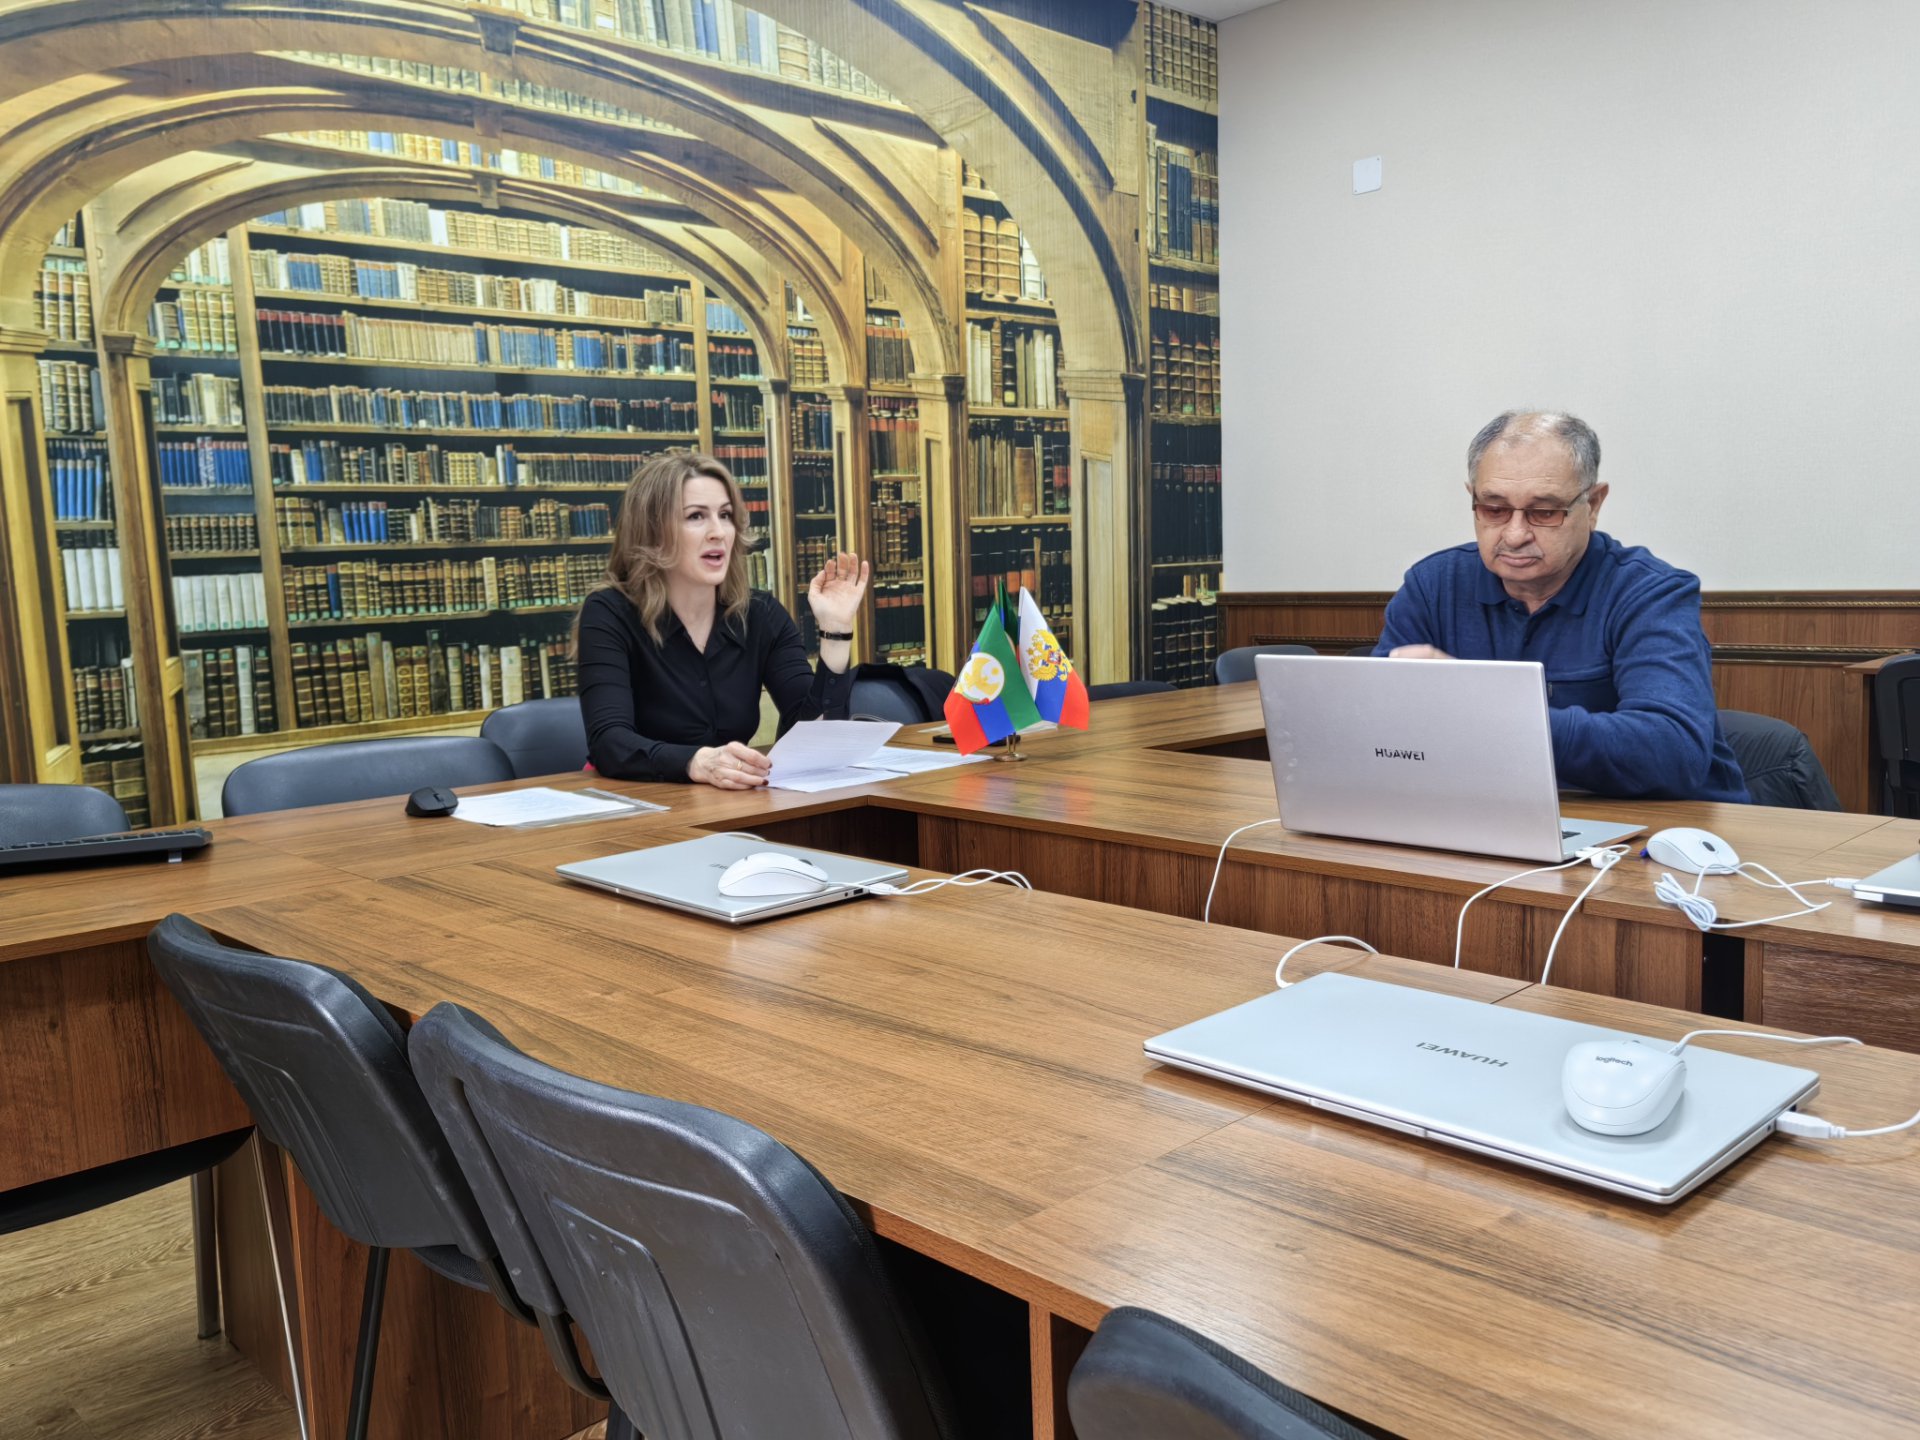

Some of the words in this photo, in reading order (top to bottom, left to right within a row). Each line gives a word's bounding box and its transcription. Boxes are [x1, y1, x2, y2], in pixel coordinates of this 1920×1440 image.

[1375, 747, 1425, 761] HUAWEI
[1415, 1041, 1508, 1068] HUAWEI
[1595, 1055, 1633, 1067] logitech
